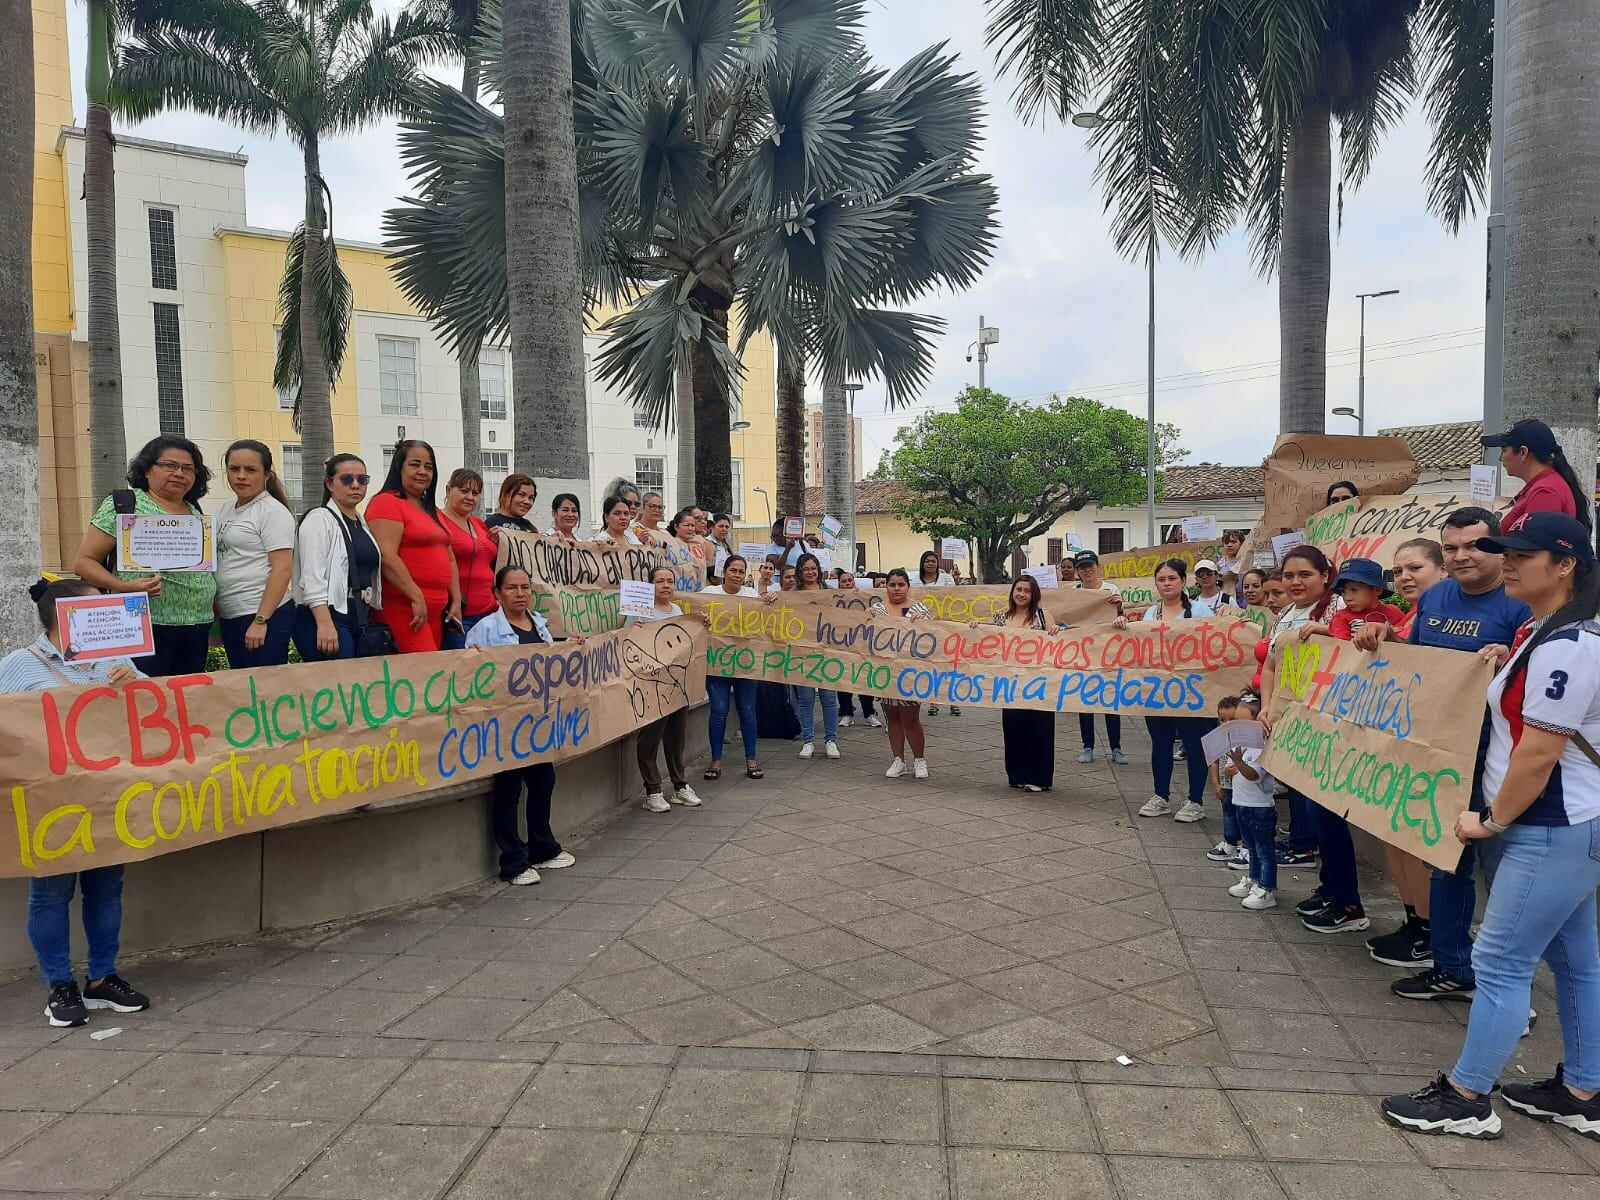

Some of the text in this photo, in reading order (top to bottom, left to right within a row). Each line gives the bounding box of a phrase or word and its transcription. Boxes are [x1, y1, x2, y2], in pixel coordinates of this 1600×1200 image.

[1275, 442, 1375, 472] Queremos
[507, 536, 533, 579] NO
[601, 549, 625, 585] EN
[1120, 586, 1153, 603] ción
[701, 600, 806, 641] Talento
[816, 612, 937, 658] humano
[943, 631, 1095, 671] queremos
[1101, 621, 1246, 671] contratos
[1442, 618, 1481, 638] DIESEL
[41, 636, 621, 776] ICBF diciendo que esperemos
[762, 643, 845, 683] plazo
[851, 660, 891, 690] no
[897, 667, 986, 702] cortos
[992, 673, 1018, 704] ni
[1022, 676, 1048, 701] a
[1056, 667, 1205, 711] pedazos
[1280, 642, 1321, 700] NO
[1318, 652, 1422, 739] mentiras
[1545, 669, 1569, 701] 3
[12, 697, 590, 870] la contratación con calma
[1333, 747, 1461, 847] acciones
